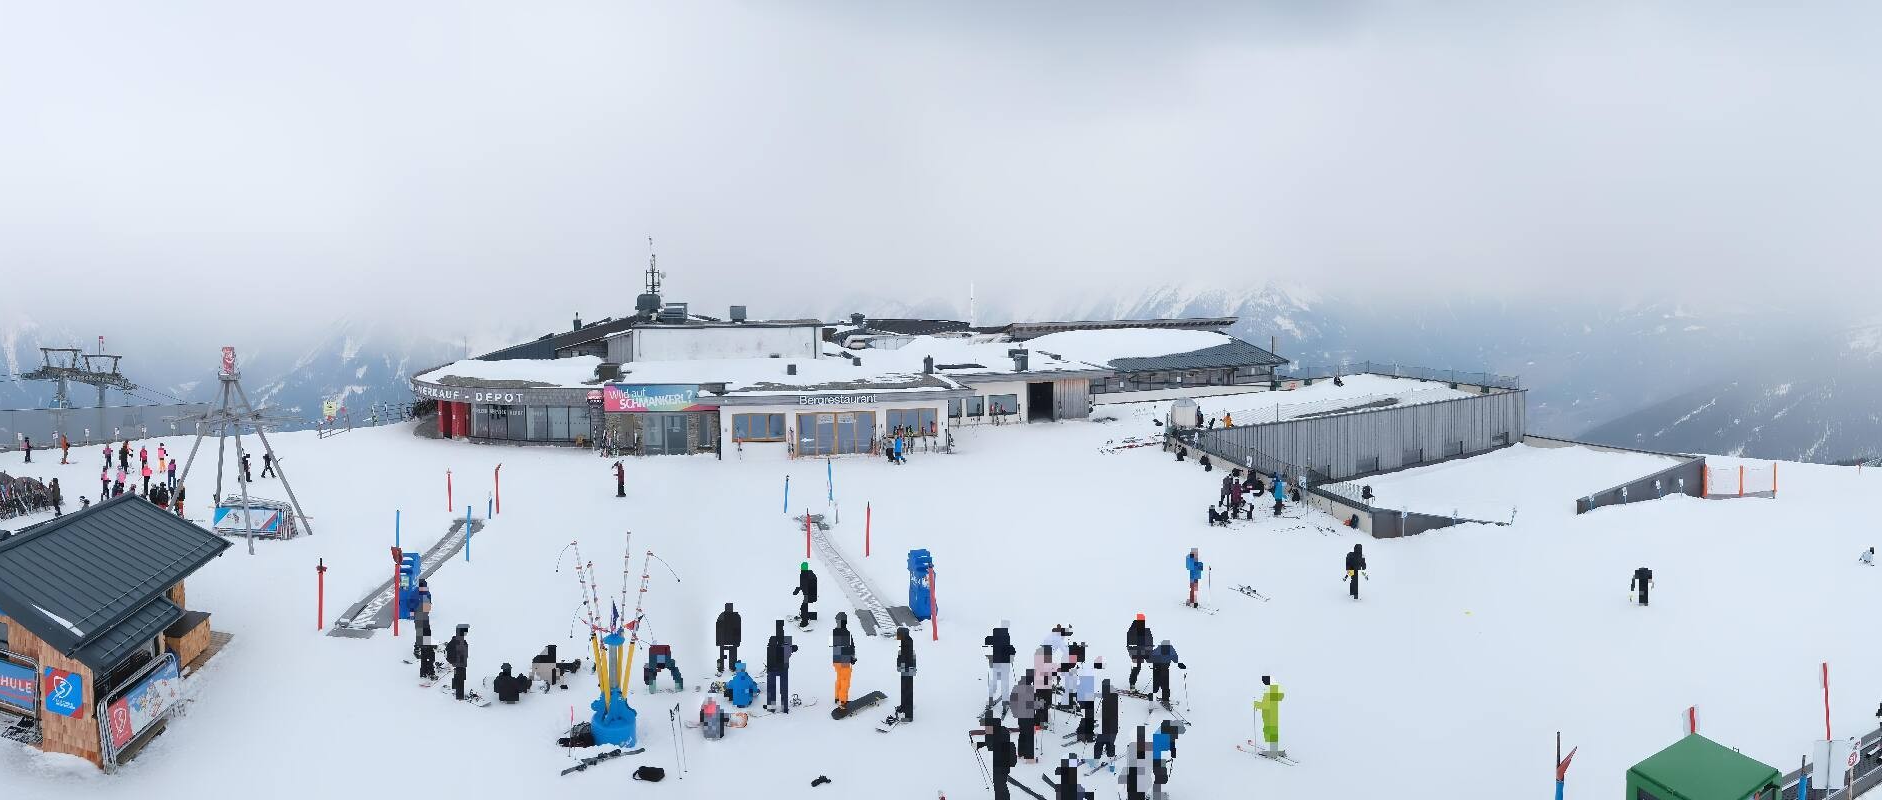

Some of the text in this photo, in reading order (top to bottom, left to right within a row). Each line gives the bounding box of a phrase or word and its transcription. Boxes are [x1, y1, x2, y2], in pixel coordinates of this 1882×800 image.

[476, 392, 524, 402] DEPOT
[609, 388, 646, 400] Wild auf
[799, 394, 877, 405] Bergrestaurant
